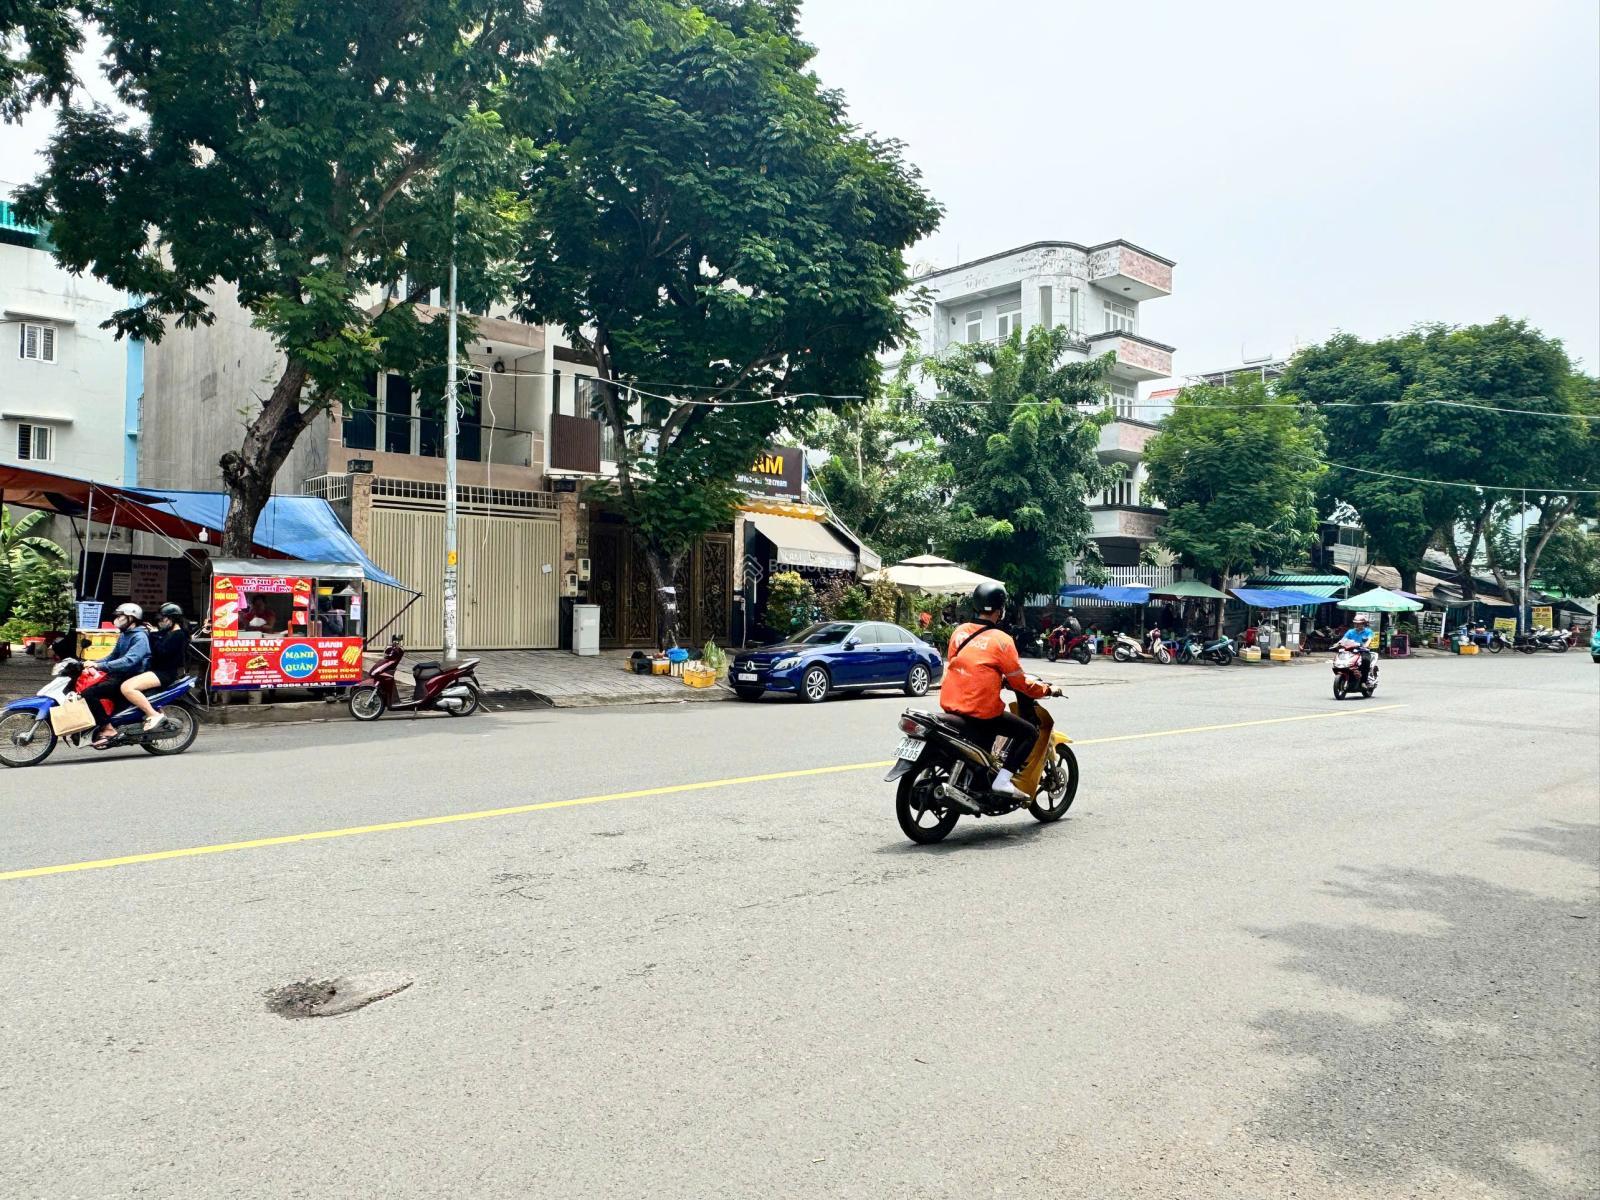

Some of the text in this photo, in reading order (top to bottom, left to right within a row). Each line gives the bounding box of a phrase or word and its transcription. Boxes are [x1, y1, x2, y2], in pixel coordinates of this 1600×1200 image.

[752, 454, 784, 475] AM
[213, 638, 256, 647] BÁNH
[285, 651, 314, 660] MẠNH
